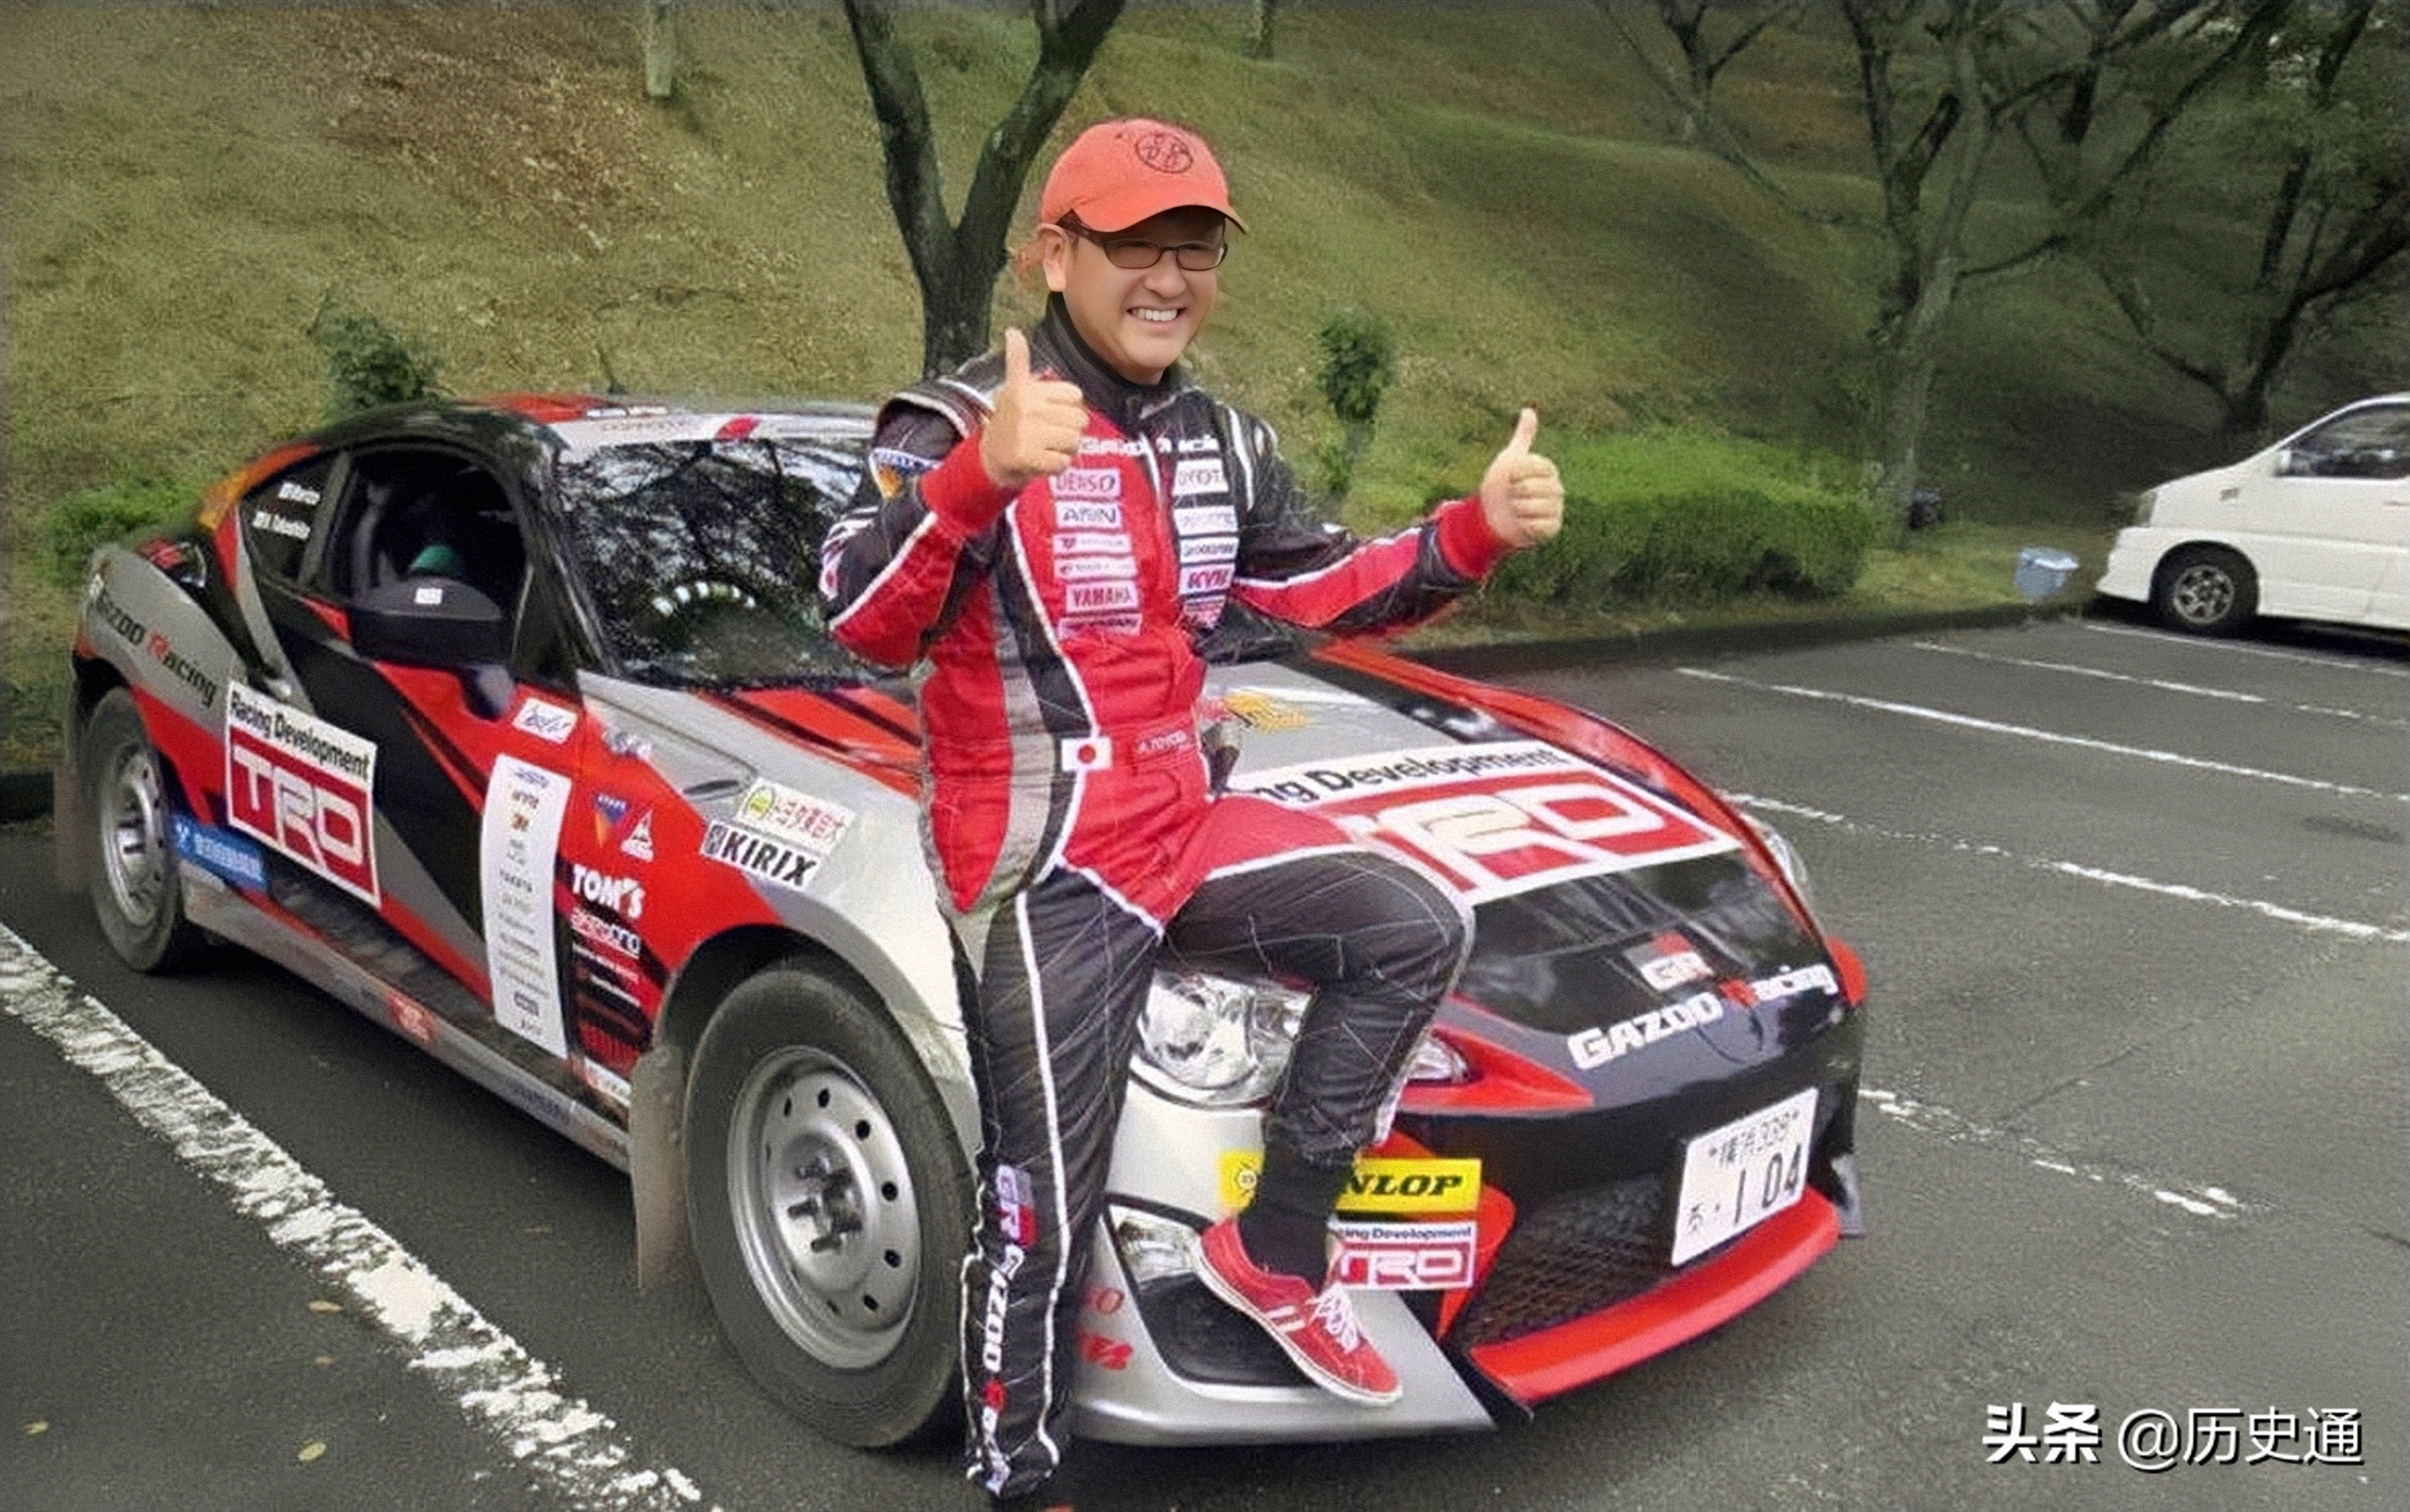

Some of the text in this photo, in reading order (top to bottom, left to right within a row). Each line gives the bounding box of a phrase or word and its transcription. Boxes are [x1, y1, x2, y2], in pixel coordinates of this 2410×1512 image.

[1072, 587, 1132, 608] YAMAHA
[232, 690, 371, 782] Racing Development
[1303, 747, 1571, 791] Development
[231, 742, 365, 870] TRD
[721, 830, 816, 887] KIRIX
[572, 862, 646, 919] TOM'S
[1567, 991, 1724, 1070] GAZOO
[1343, 1174, 1463, 1196] NLOP
[1372, 1227, 1471, 1239] Development
